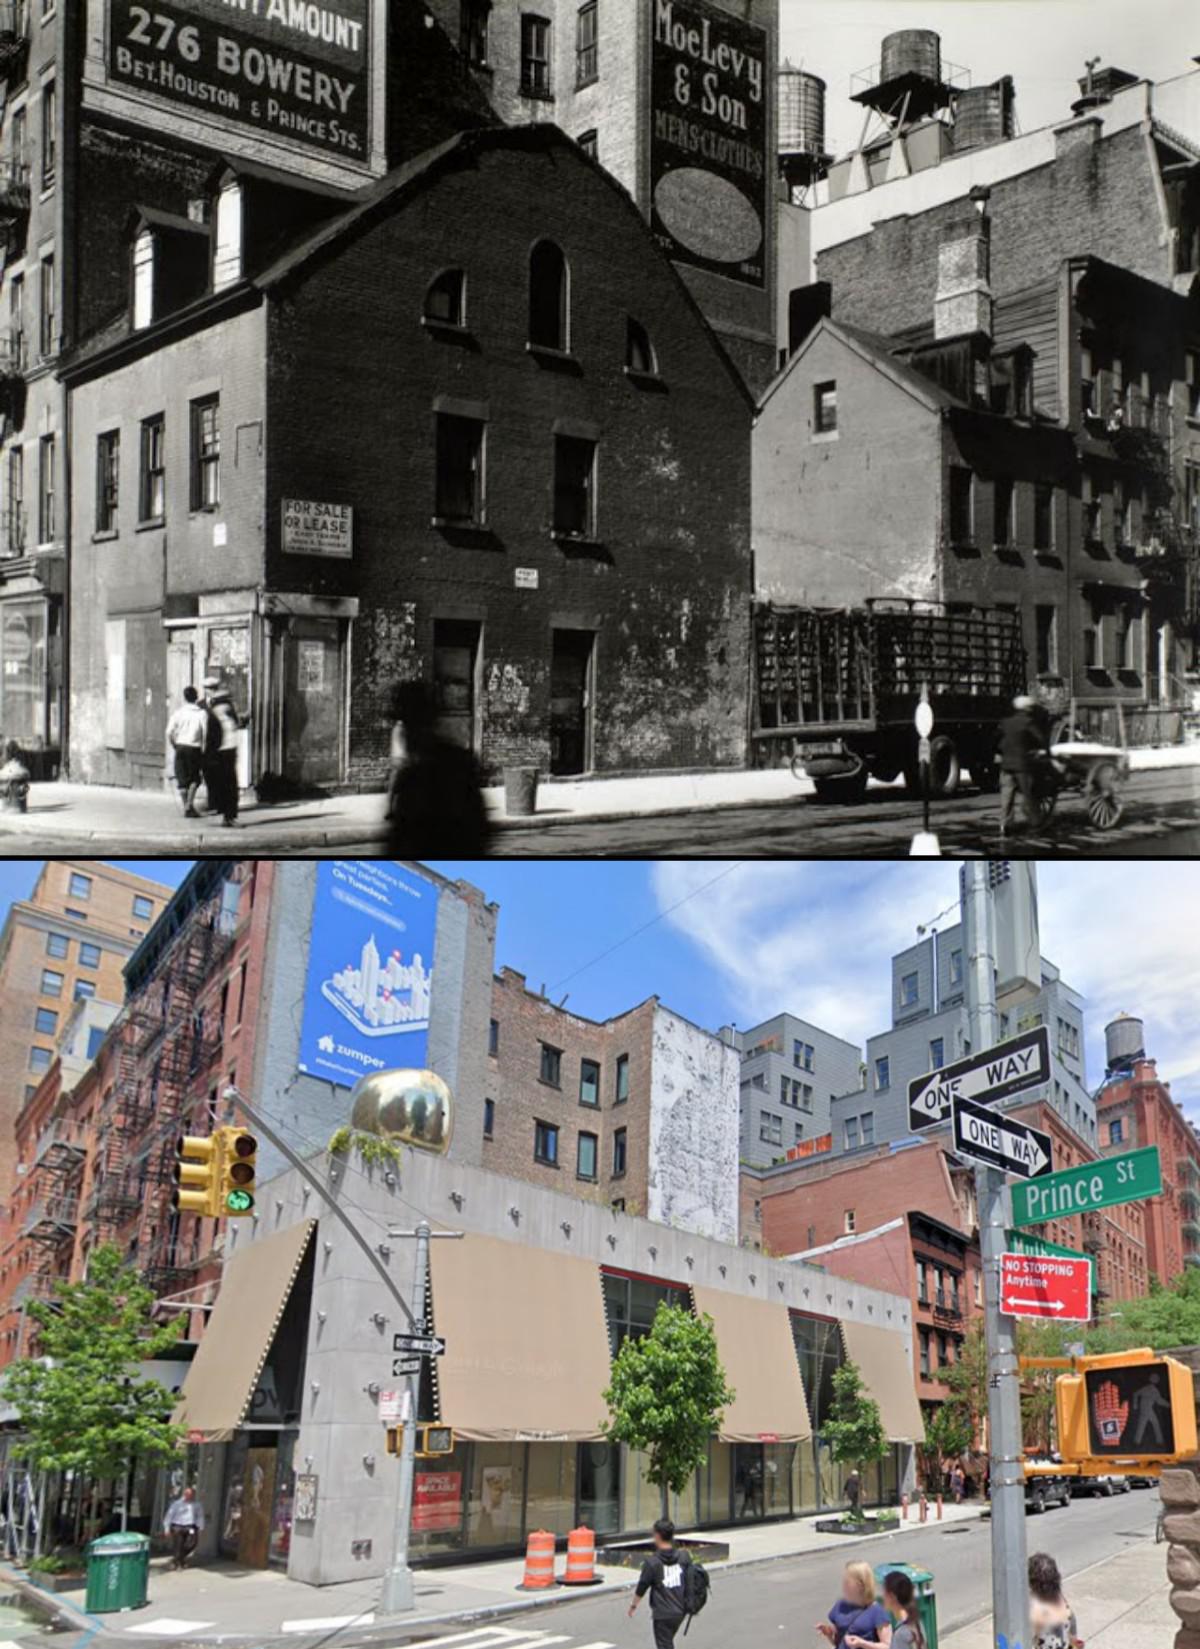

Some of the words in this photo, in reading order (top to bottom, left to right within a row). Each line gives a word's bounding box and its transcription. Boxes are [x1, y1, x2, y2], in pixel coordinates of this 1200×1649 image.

[266, 0, 362, 51] AMOUNT
[127, 6, 200, 62] 276
[217, 36, 355, 114] BOWERY
[674, 64, 691, 104] &
[702, 72, 747, 130] Son
[286, 501, 310, 514] FOR
[314, 503, 349, 519] SALE
[303, 517, 347, 533] LEASE
[337, 1044, 385, 1068] zumper
[986, 1048, 1034, 1086] WAY
[969, 1119, 1000, 1151] ONE
[1011, 1136, 1040, 1166] WAY
[1026, 1175, 1104, 1217] Prince
[1116, 1159, 1136, 1184] St
[1005, 1259, 1020, 1272] NO
[1023, 1261, 1074, 1277] STOPPING
[1006, 1273, 1048, 1288] Anytime
